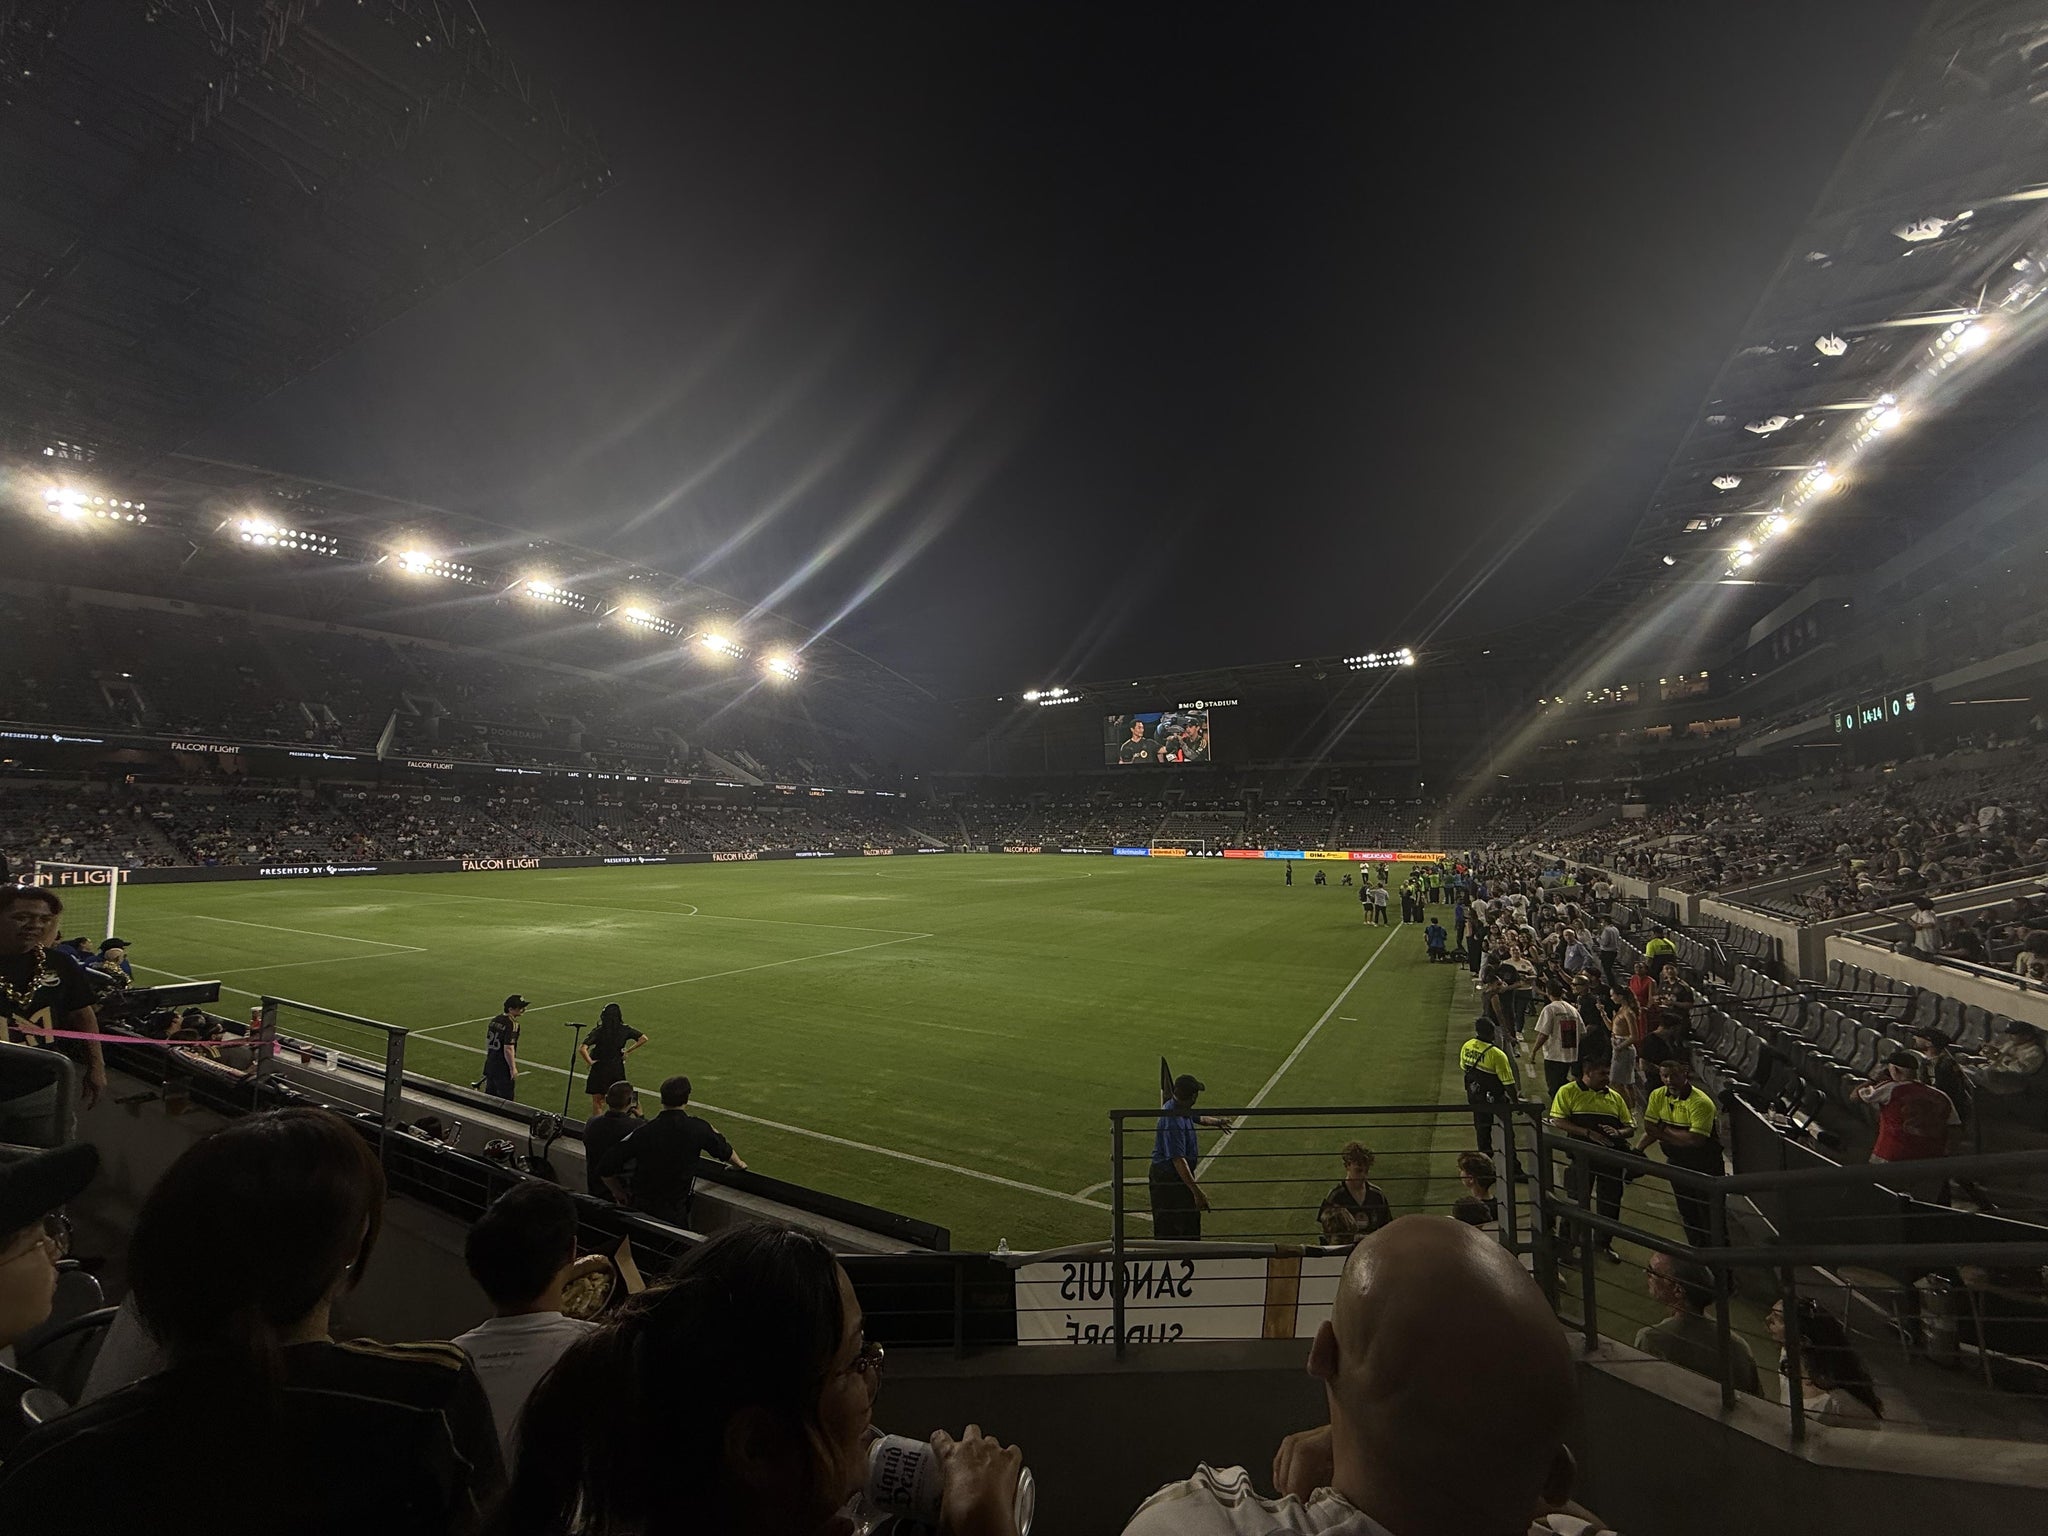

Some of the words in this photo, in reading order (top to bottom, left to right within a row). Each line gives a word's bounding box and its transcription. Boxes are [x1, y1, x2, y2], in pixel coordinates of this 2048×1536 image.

[1204, 699, 1238, 707] STADIUM
[1846, 714, 1853, 729] 0
[1862, 706, 1882, 724] 14:14
[1892, 699, 1900, 716] 0
[0, 732, 38, 740] PRESENTED
[491, 727, 543, 739] DOORDASH
[171, 742, 207, 752] FALCON
[209, 744, 240, 754] FLIGHT
[712, 853, 737, 861] FALCON
[738, 852, 758, 860] FLIGHT
[462, 859, 504, 870] FALCON
[506, 858, 540, 869] FLIGHT
[260, 867, 310, 875] PRESENTED
